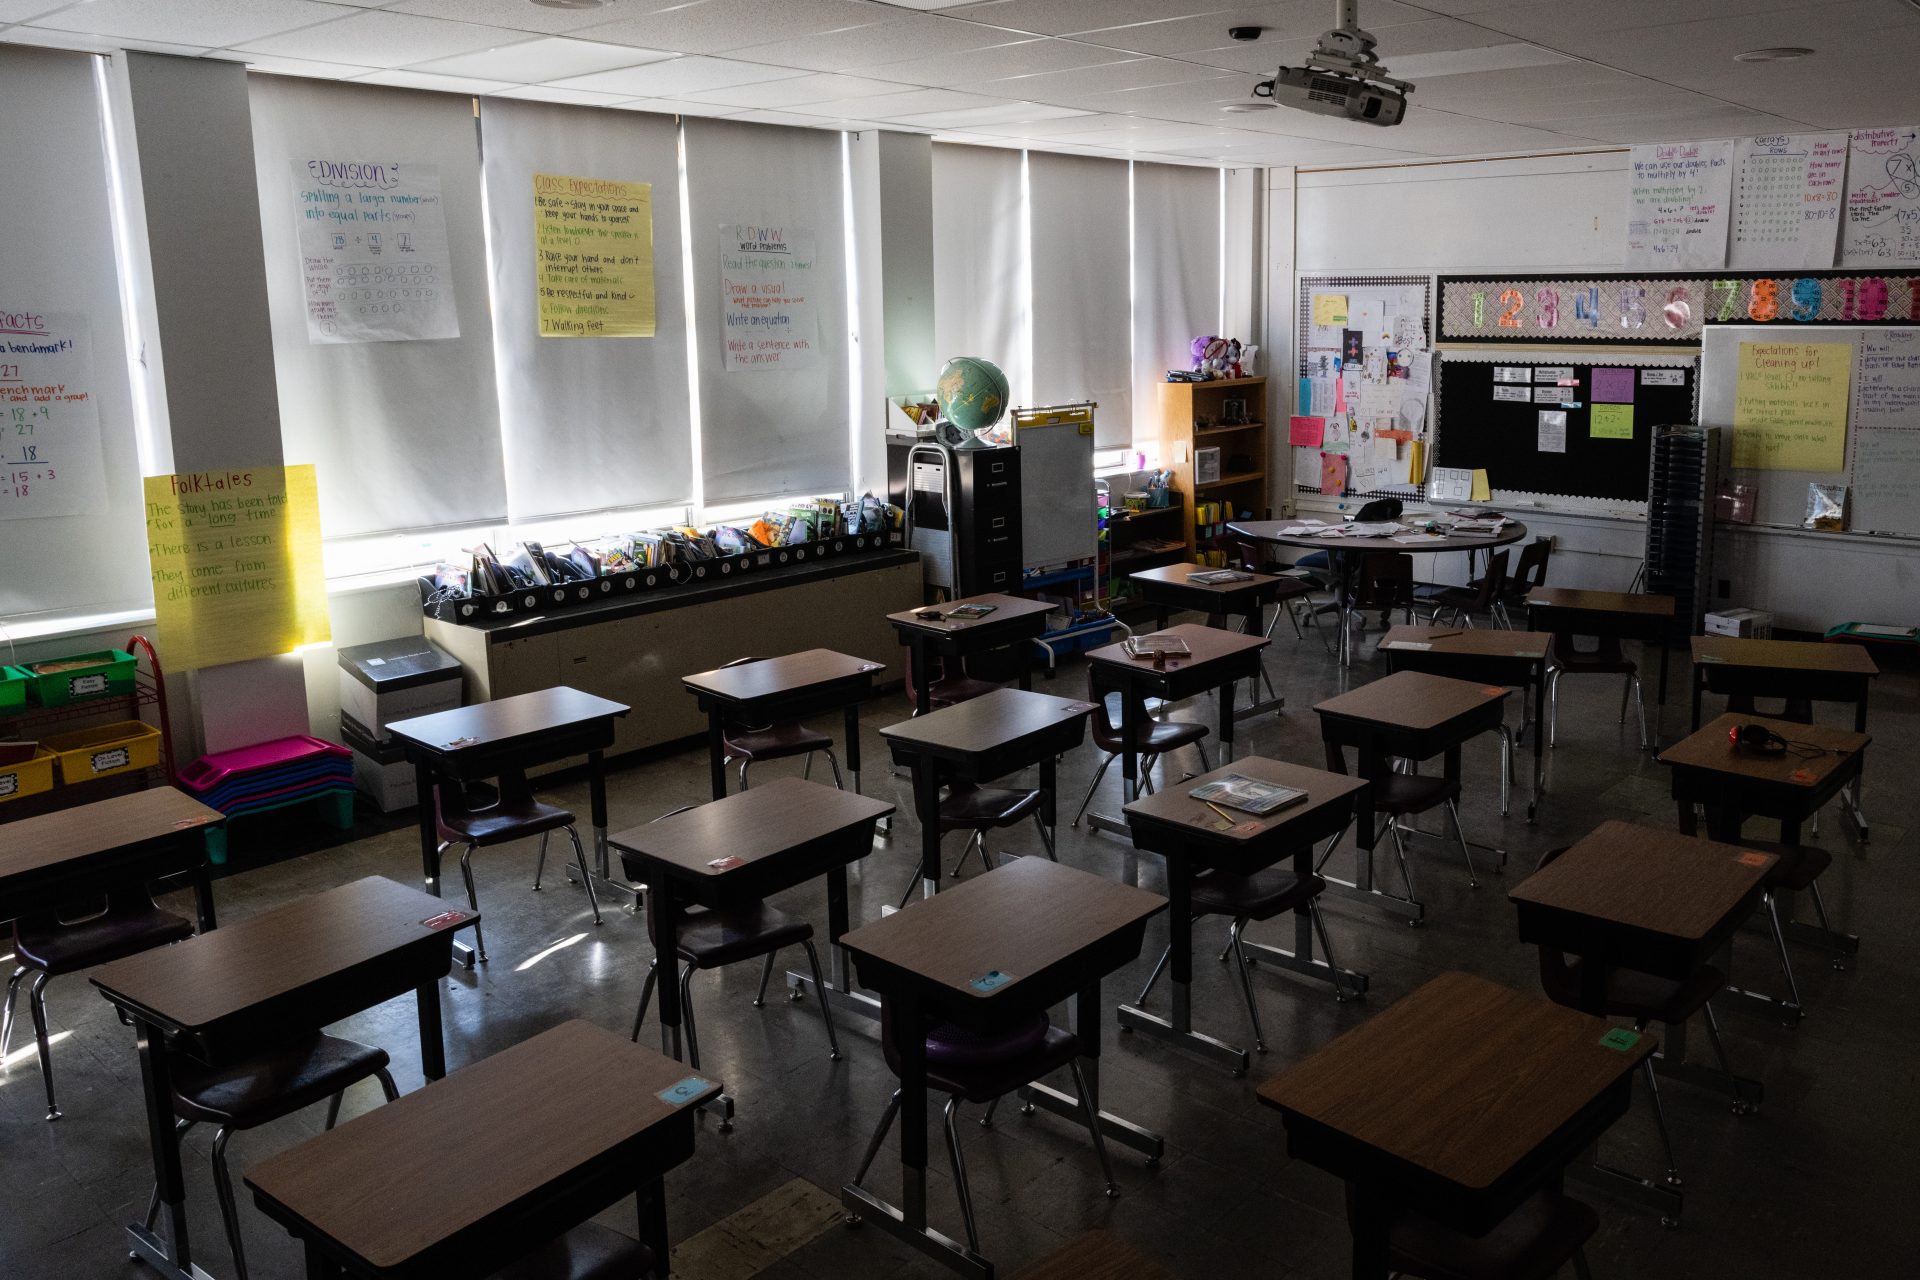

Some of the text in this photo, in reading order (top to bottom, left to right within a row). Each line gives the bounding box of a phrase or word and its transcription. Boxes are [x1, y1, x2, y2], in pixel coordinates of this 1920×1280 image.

[536, 175, 627, 196] Class Expectations
[562, 212, 577, 222] your
[580, 212, 598, 222] hands
[564, 254, 578, 263] your
[582, 253, 599, 263] hand
[603, 256, 615, 264] and
[545, 264, 579, 274] interrupt
[725, 279, 747, 295] Draw
[762, 280, 785, 293] visual
[595, 291, 608, 299] and
[1472, 278, 1889, 329] 1 2 3 4 5 6 7 8 9 10
[552, 320, 585, 334] Walking
[727, 313, 748, 327] Write
[728, 340, 746, 352] Write
[758, 340, 790, 351] sentence
[1752, 345, 1818, 357] Expectations for
[1755, 359, 1797, 372] Cleaning
[34, 394, 51, 402] add
[16, 425, 35, 436] 27
[22, 446, 37, 462] 18
[171, 472, 254, 496] Folktales
[148, 493, 289, 517] The story has been told
[155, 508, 277, 530] for a long time
[198, 541, 208, 552] is
[215, 542, 224, 551] a
[230, 534, 272, 548] lesson
[156, 560, 266, 583] They come from
[167, 577, 277, 602] different cultures
